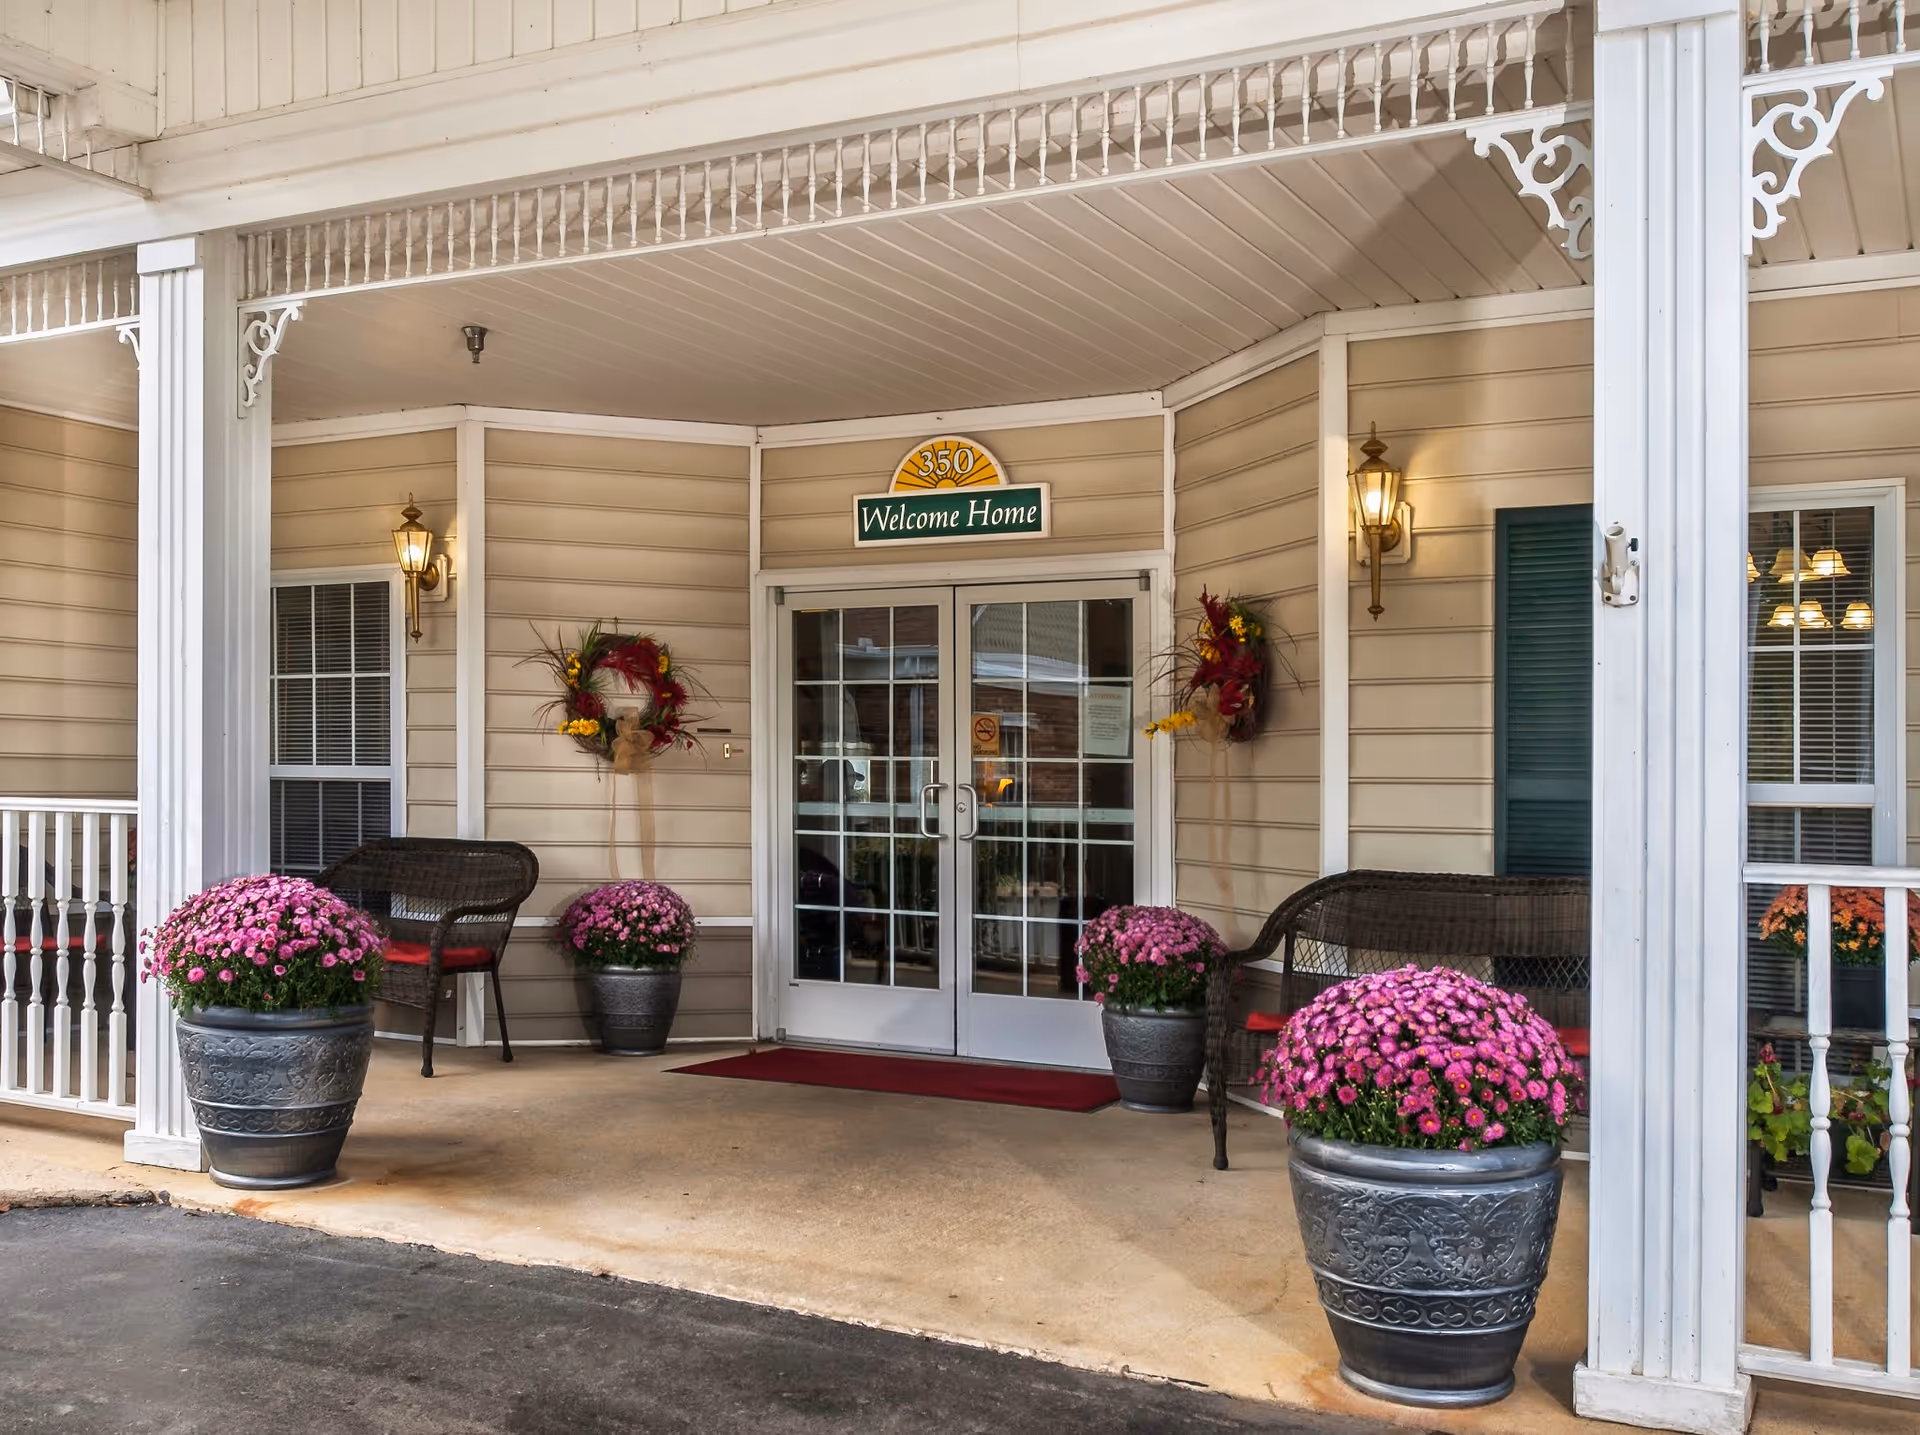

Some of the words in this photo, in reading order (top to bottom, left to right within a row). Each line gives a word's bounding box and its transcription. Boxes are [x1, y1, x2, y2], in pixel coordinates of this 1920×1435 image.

[918, 448, 975, 477] 350
[861, 502, 960, 533] Welcome
[966, 498, 1038, 527] Home
